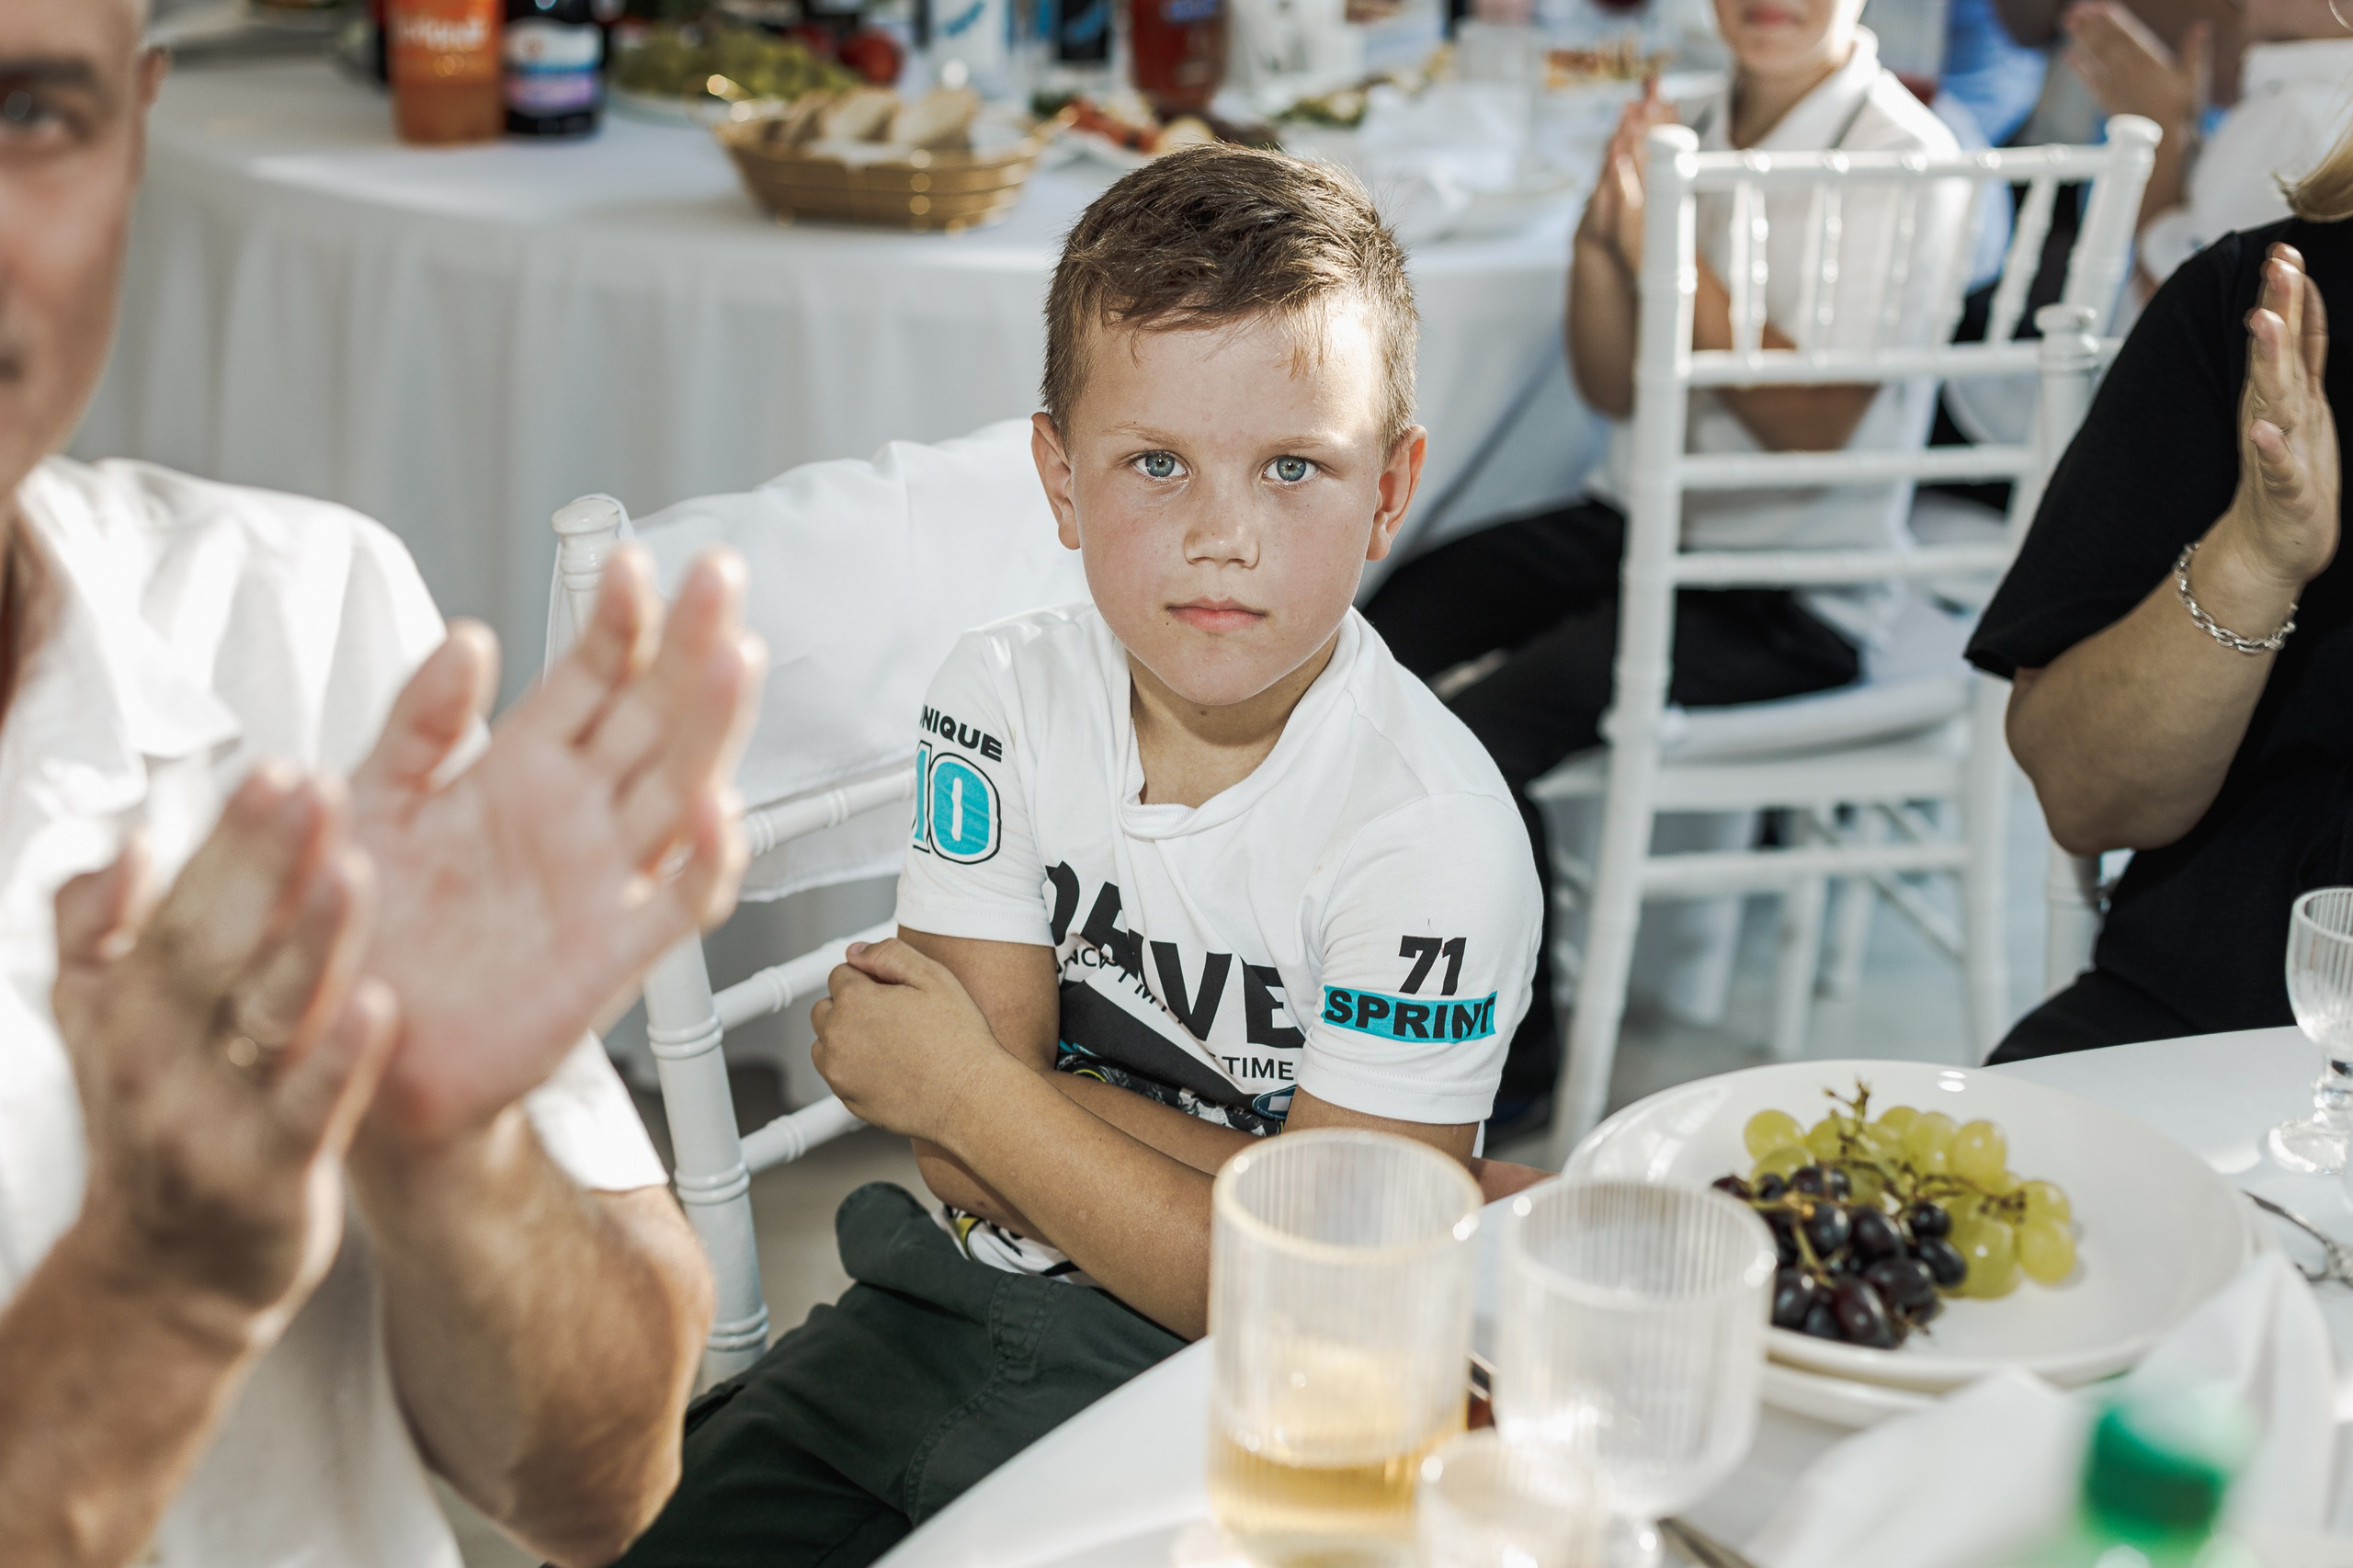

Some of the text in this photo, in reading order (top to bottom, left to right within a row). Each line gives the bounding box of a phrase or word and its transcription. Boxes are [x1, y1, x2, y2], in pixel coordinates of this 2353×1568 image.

[920, 704, 1003, 763] NIQUE
[1398, 935, 1467, 996] 71
[1222, 1056, 1294, 1081] TIME
